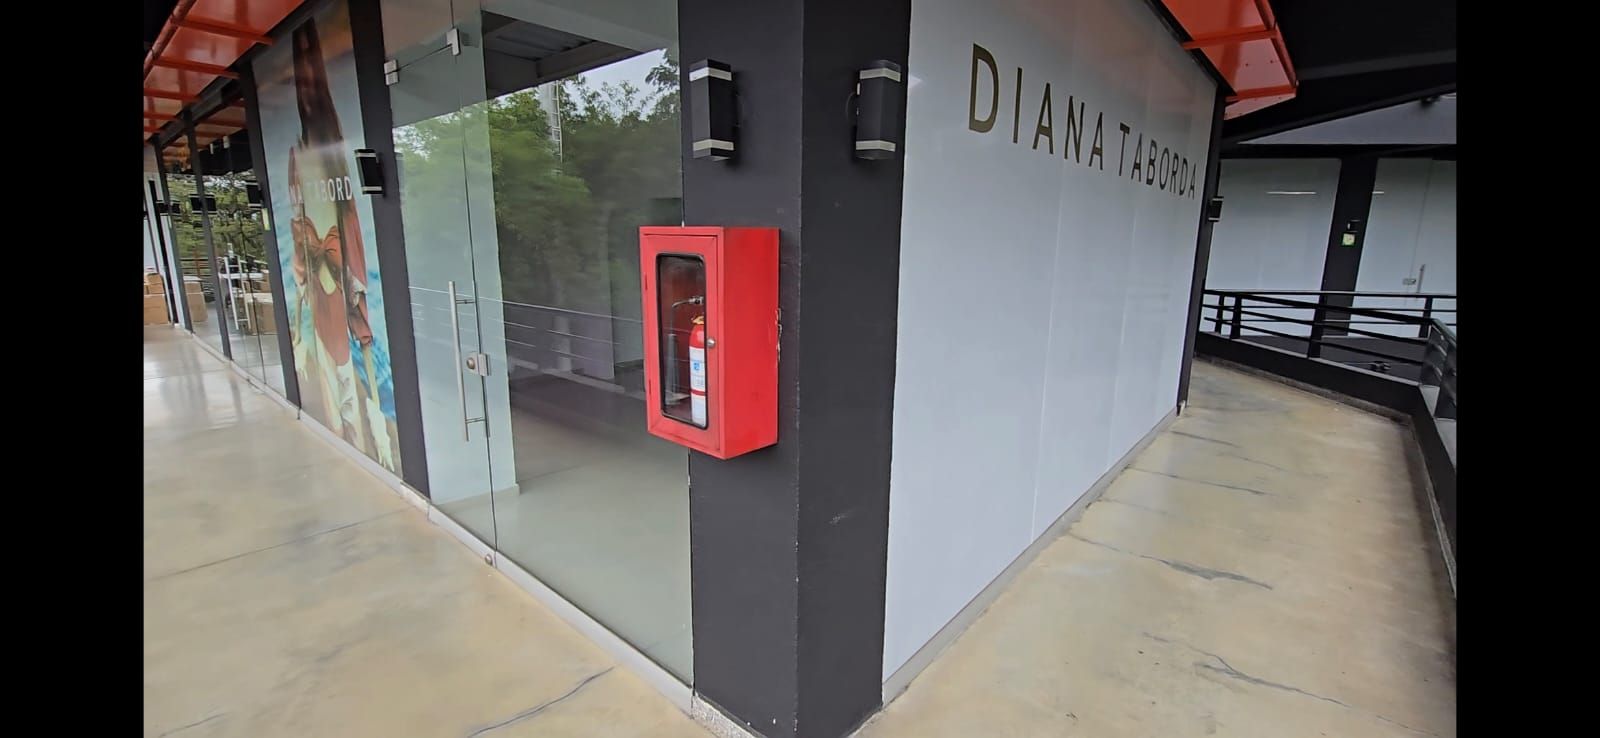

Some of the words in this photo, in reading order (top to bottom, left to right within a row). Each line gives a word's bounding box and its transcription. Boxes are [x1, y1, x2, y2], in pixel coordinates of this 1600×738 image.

[969, 42, 1104, 171] DIANA
[1119, 121, 1197, 200] TABORDA
[305, 176, 354, 203] TABORD
